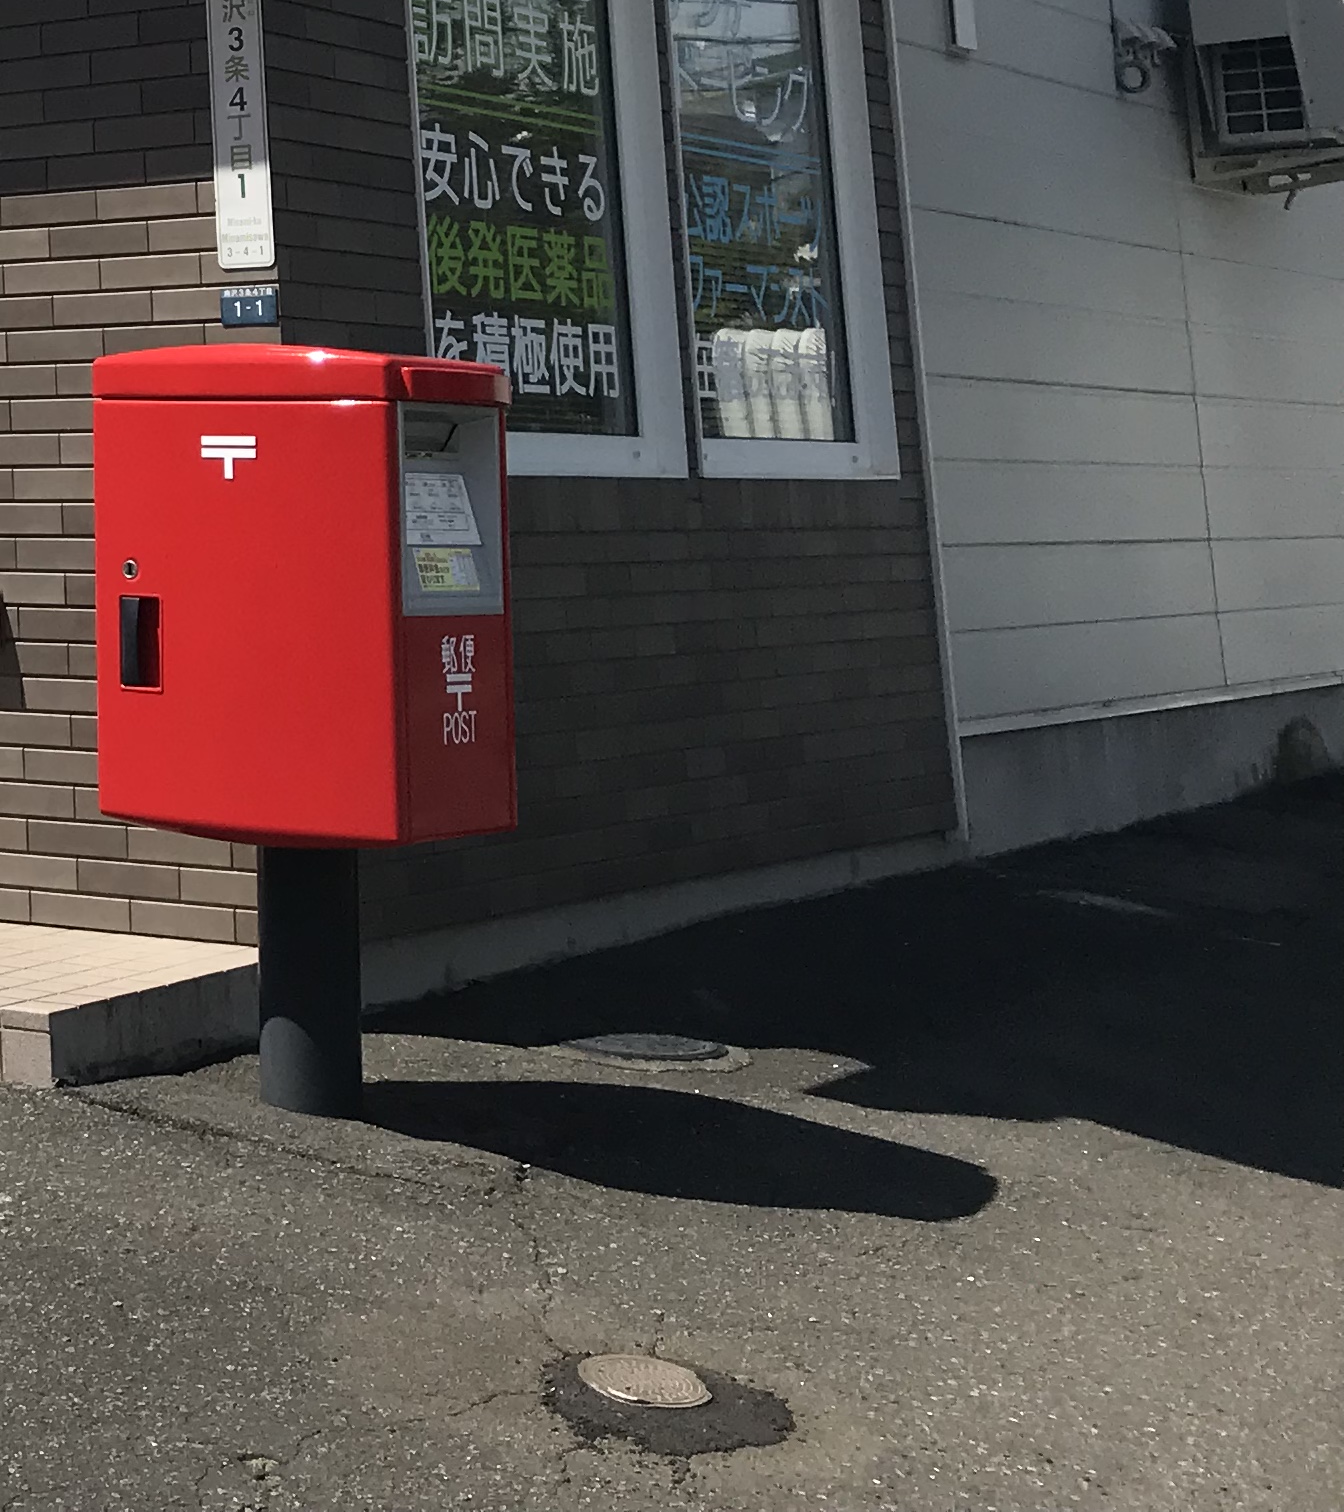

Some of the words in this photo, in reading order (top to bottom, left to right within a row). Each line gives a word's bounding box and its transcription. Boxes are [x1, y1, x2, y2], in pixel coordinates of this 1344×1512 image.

[420, 122, 605, 221] 安心できる
[427, 212, 615, 309] 後発医薬品
[234, 299, 263, 318] 1-1
[435, 310, 620, 399] を積極使用
[441, 635, 476, 673] 郵便
[443, 710, 477, 745] POST
